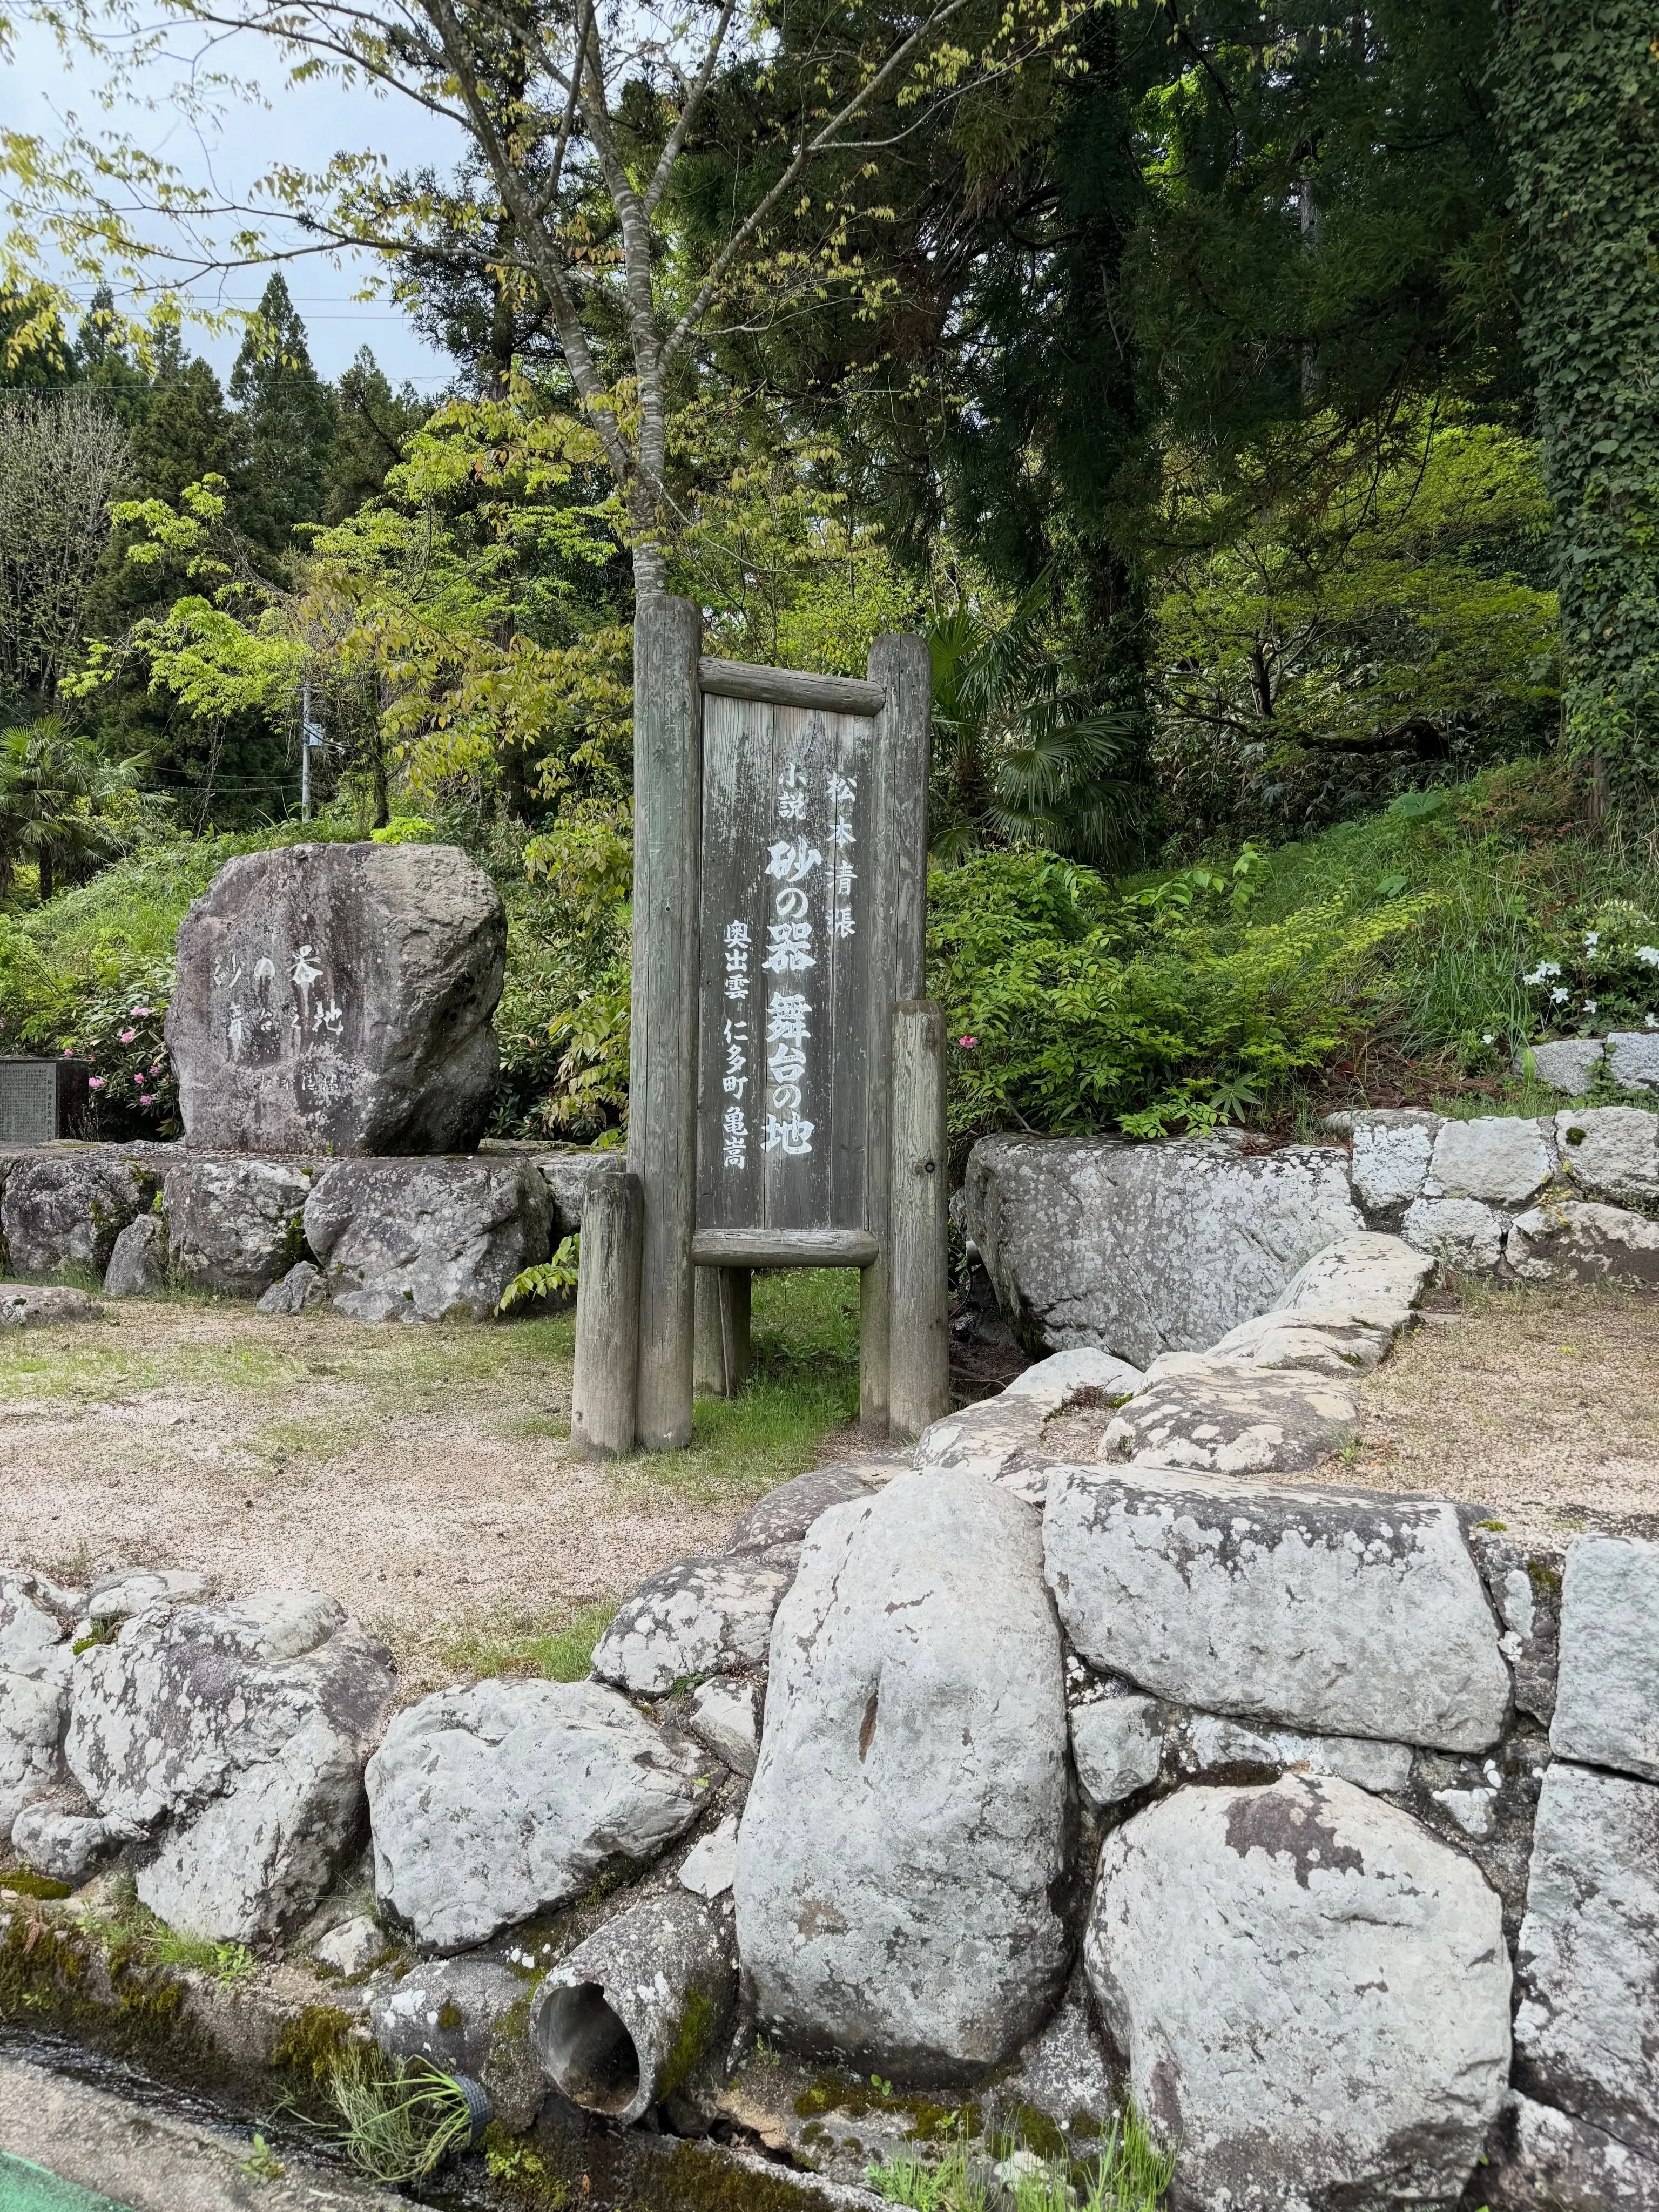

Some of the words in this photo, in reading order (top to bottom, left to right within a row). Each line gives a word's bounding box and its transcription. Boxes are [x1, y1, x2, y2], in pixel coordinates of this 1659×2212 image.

[778, 761, 806, 820] 小説
[825, 770, 858, 938] 松本清張
[761, 835, 822, 974] 砂の器
[723, 919, 752, 1000] 奥出雲
[722, 1019, 749, 1100] 仁多町
[760, 991, 815, 1155] 舞台の地
[722, 1105, 749, 1170] 亀嵩
